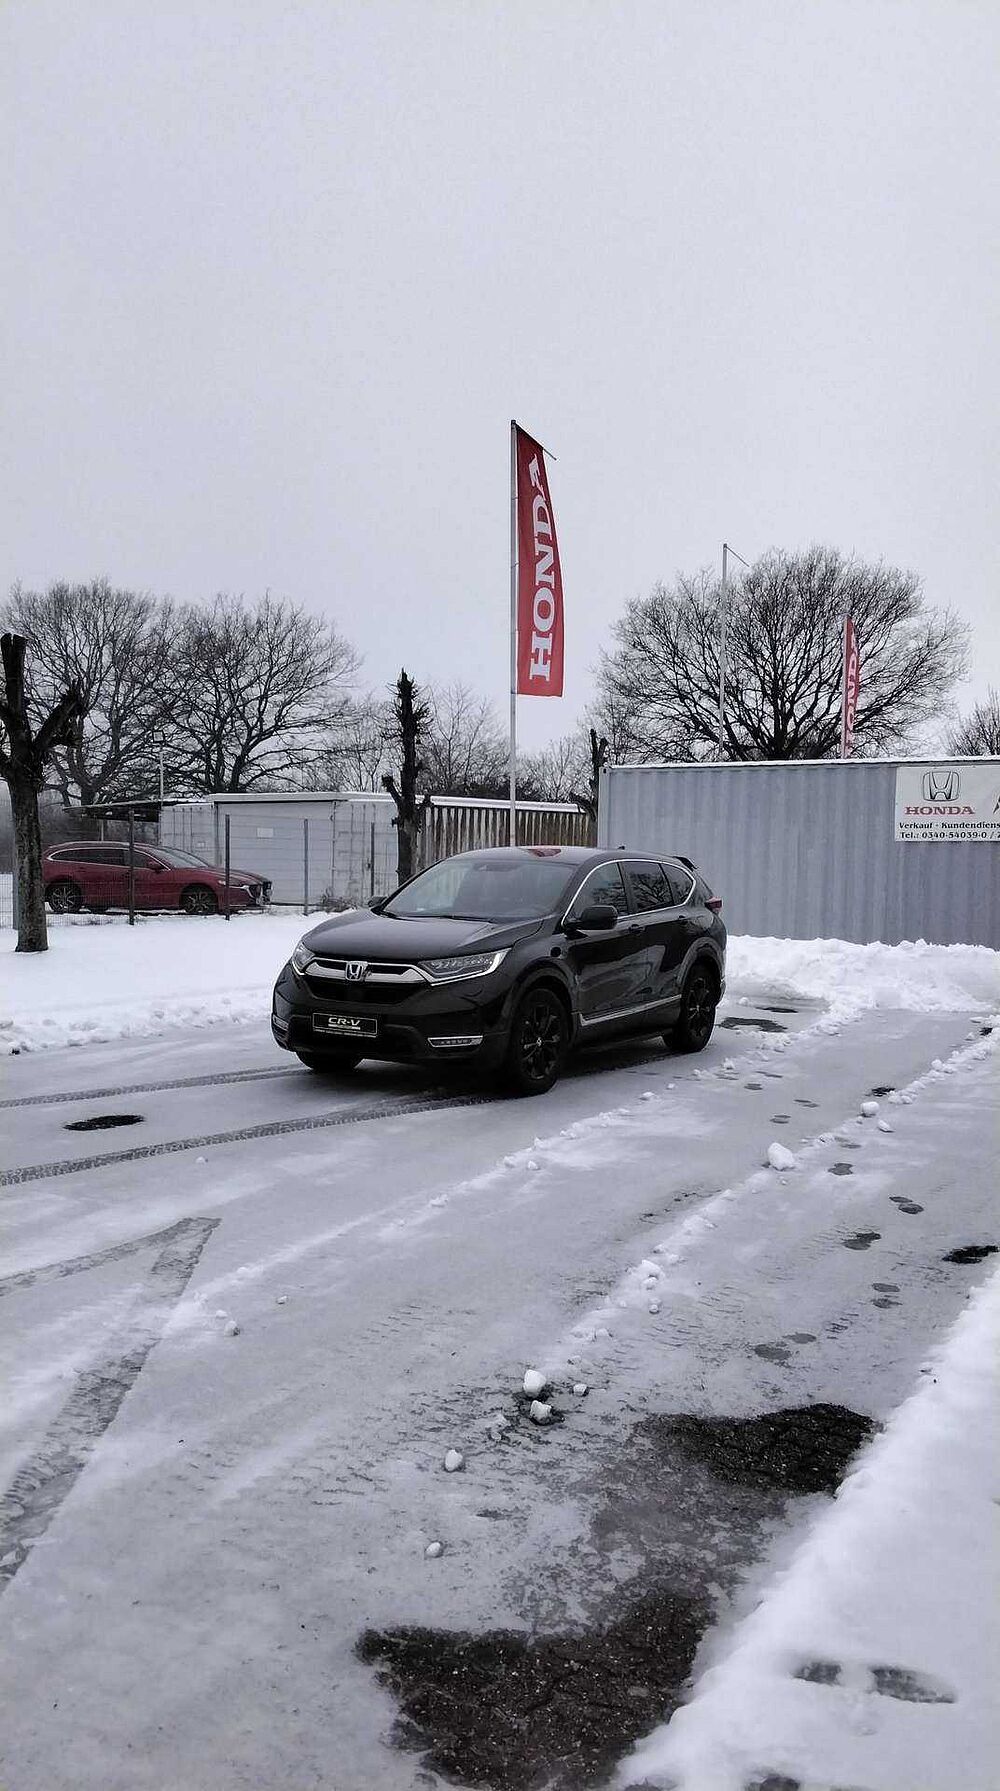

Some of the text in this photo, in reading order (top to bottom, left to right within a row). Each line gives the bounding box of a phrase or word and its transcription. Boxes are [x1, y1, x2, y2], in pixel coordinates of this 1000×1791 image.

[528, 453, 555, 681] HONDA
[905, 806, 975, 815] HONDA
[328, 1017, 361, 1026] CR-V
